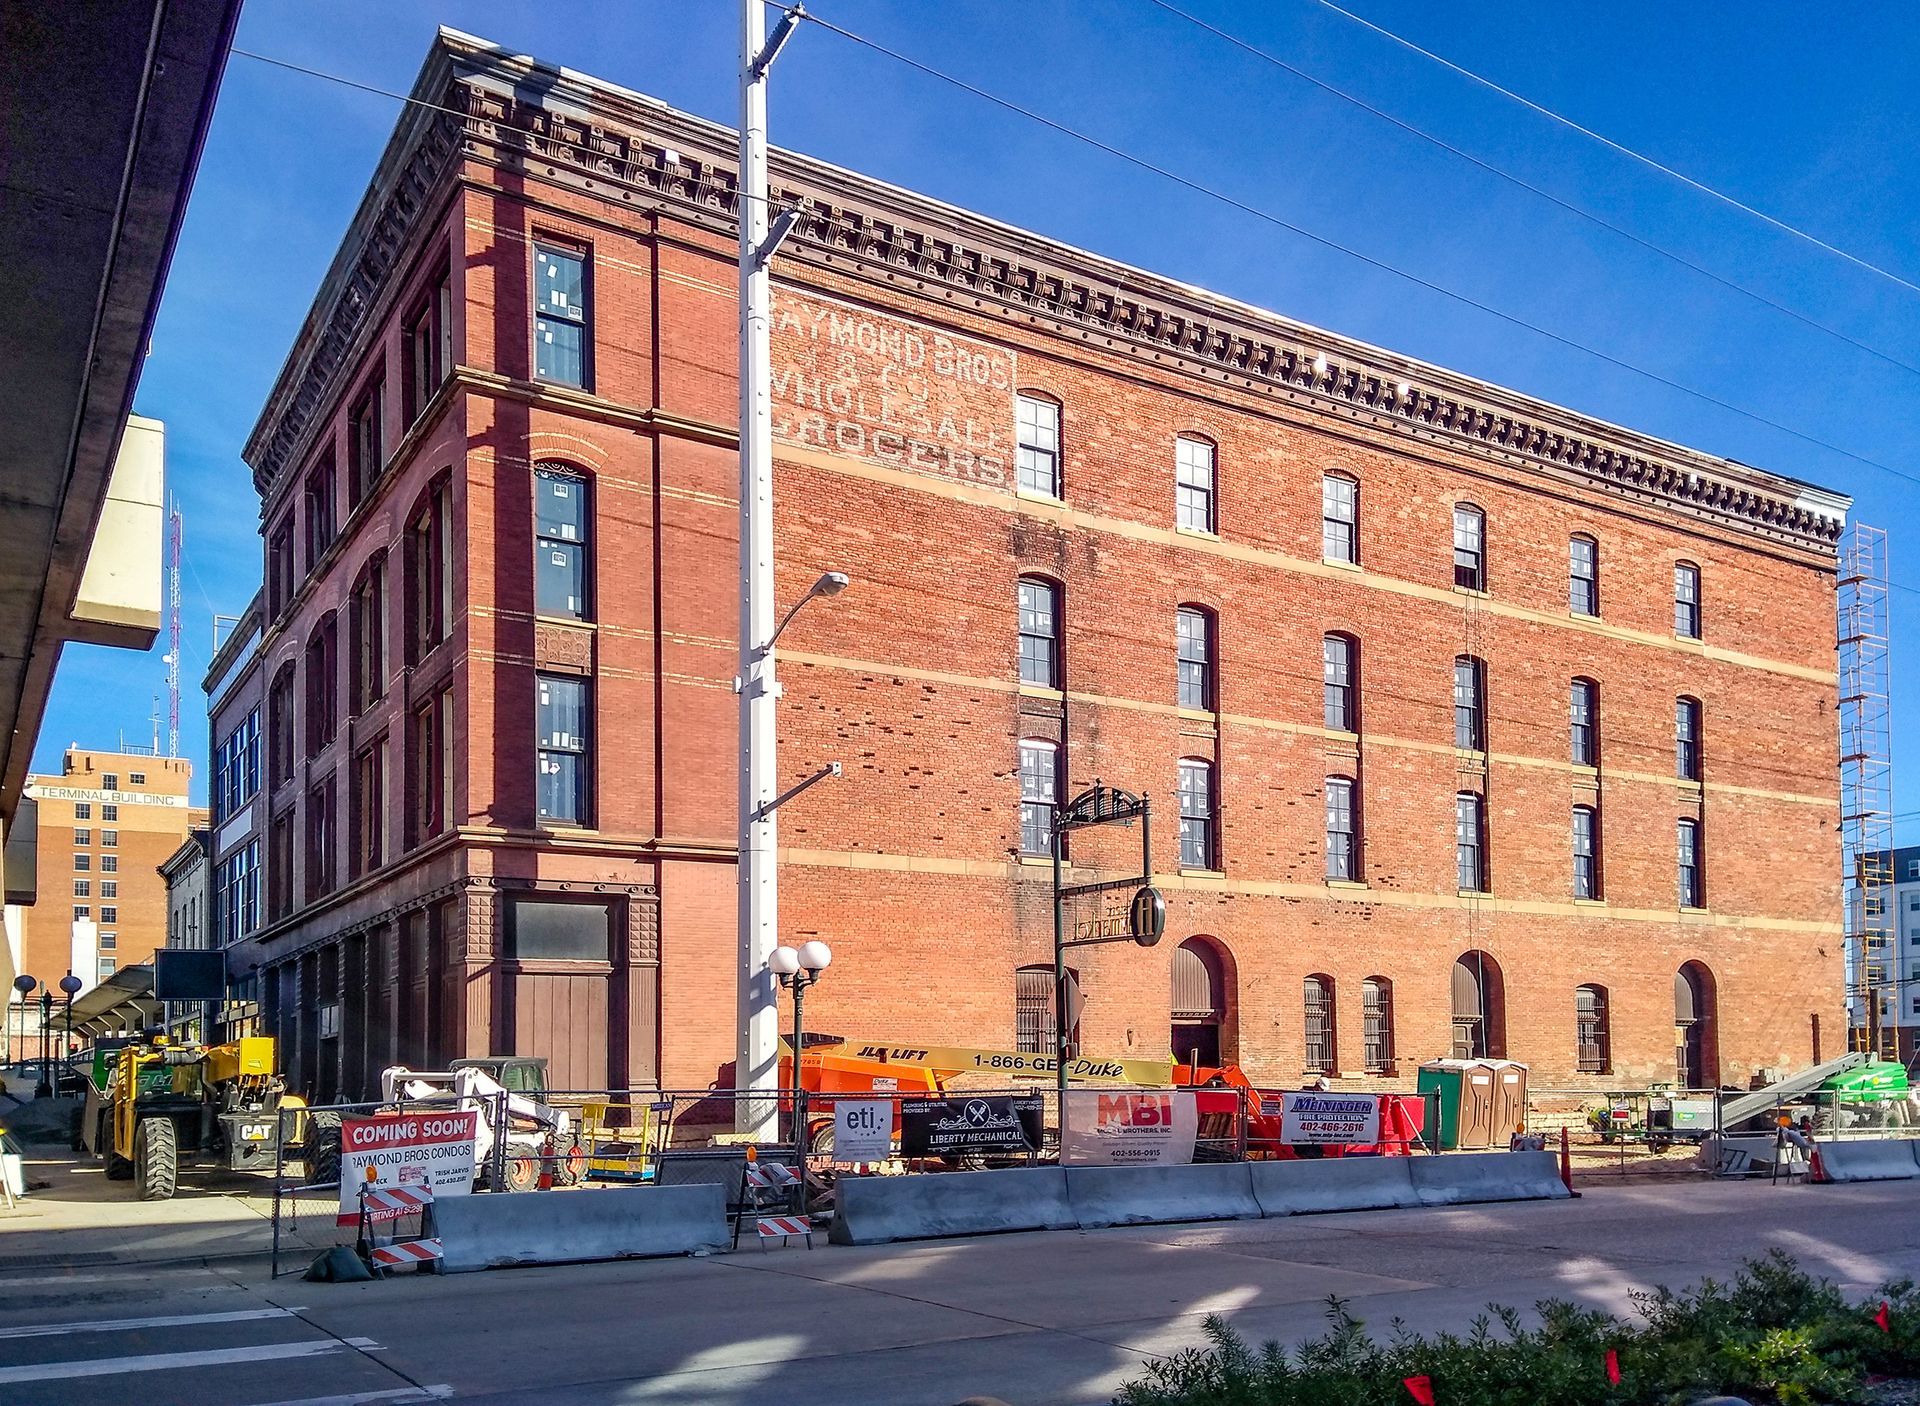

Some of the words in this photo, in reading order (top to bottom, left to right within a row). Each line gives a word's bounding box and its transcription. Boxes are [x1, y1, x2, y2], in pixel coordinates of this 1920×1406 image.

[770, 301, 926, 368] AYMOND
[40, 787, 109, 801] TERMINAL
[111, 793, 174, 806] BUILDING
[1138, 896, 1155, 937] H
[890, 1049, 929, 1061] LIFT
[974, 1054, 1124, 1077] 1-866-GE-Duke
[1098, 1094, 1172, 1126] MBI
[1290, 1096, 1373, 1114] MEININGER
[846, 1106, 875, 1130] eti
[1300, 1121, 1364, 1132] 402-466-2616
[241, 1124, 272, 1141] CAT
[352, 1122, 418, 1145] COMING
[422, 1118, 468, 1138] SOON!
[930, 1134, 966, 1144] LIBERTY
[967, 1131, 1023, 1142] MECHANICAL
[404, 1149, 430, 1163] BROS
[431, 1144, 471, 1160] CONDOS
[1110, 1149, 1161, 1157] 402-556-0915
[451, 1166, 470, 1175] JARVIS
